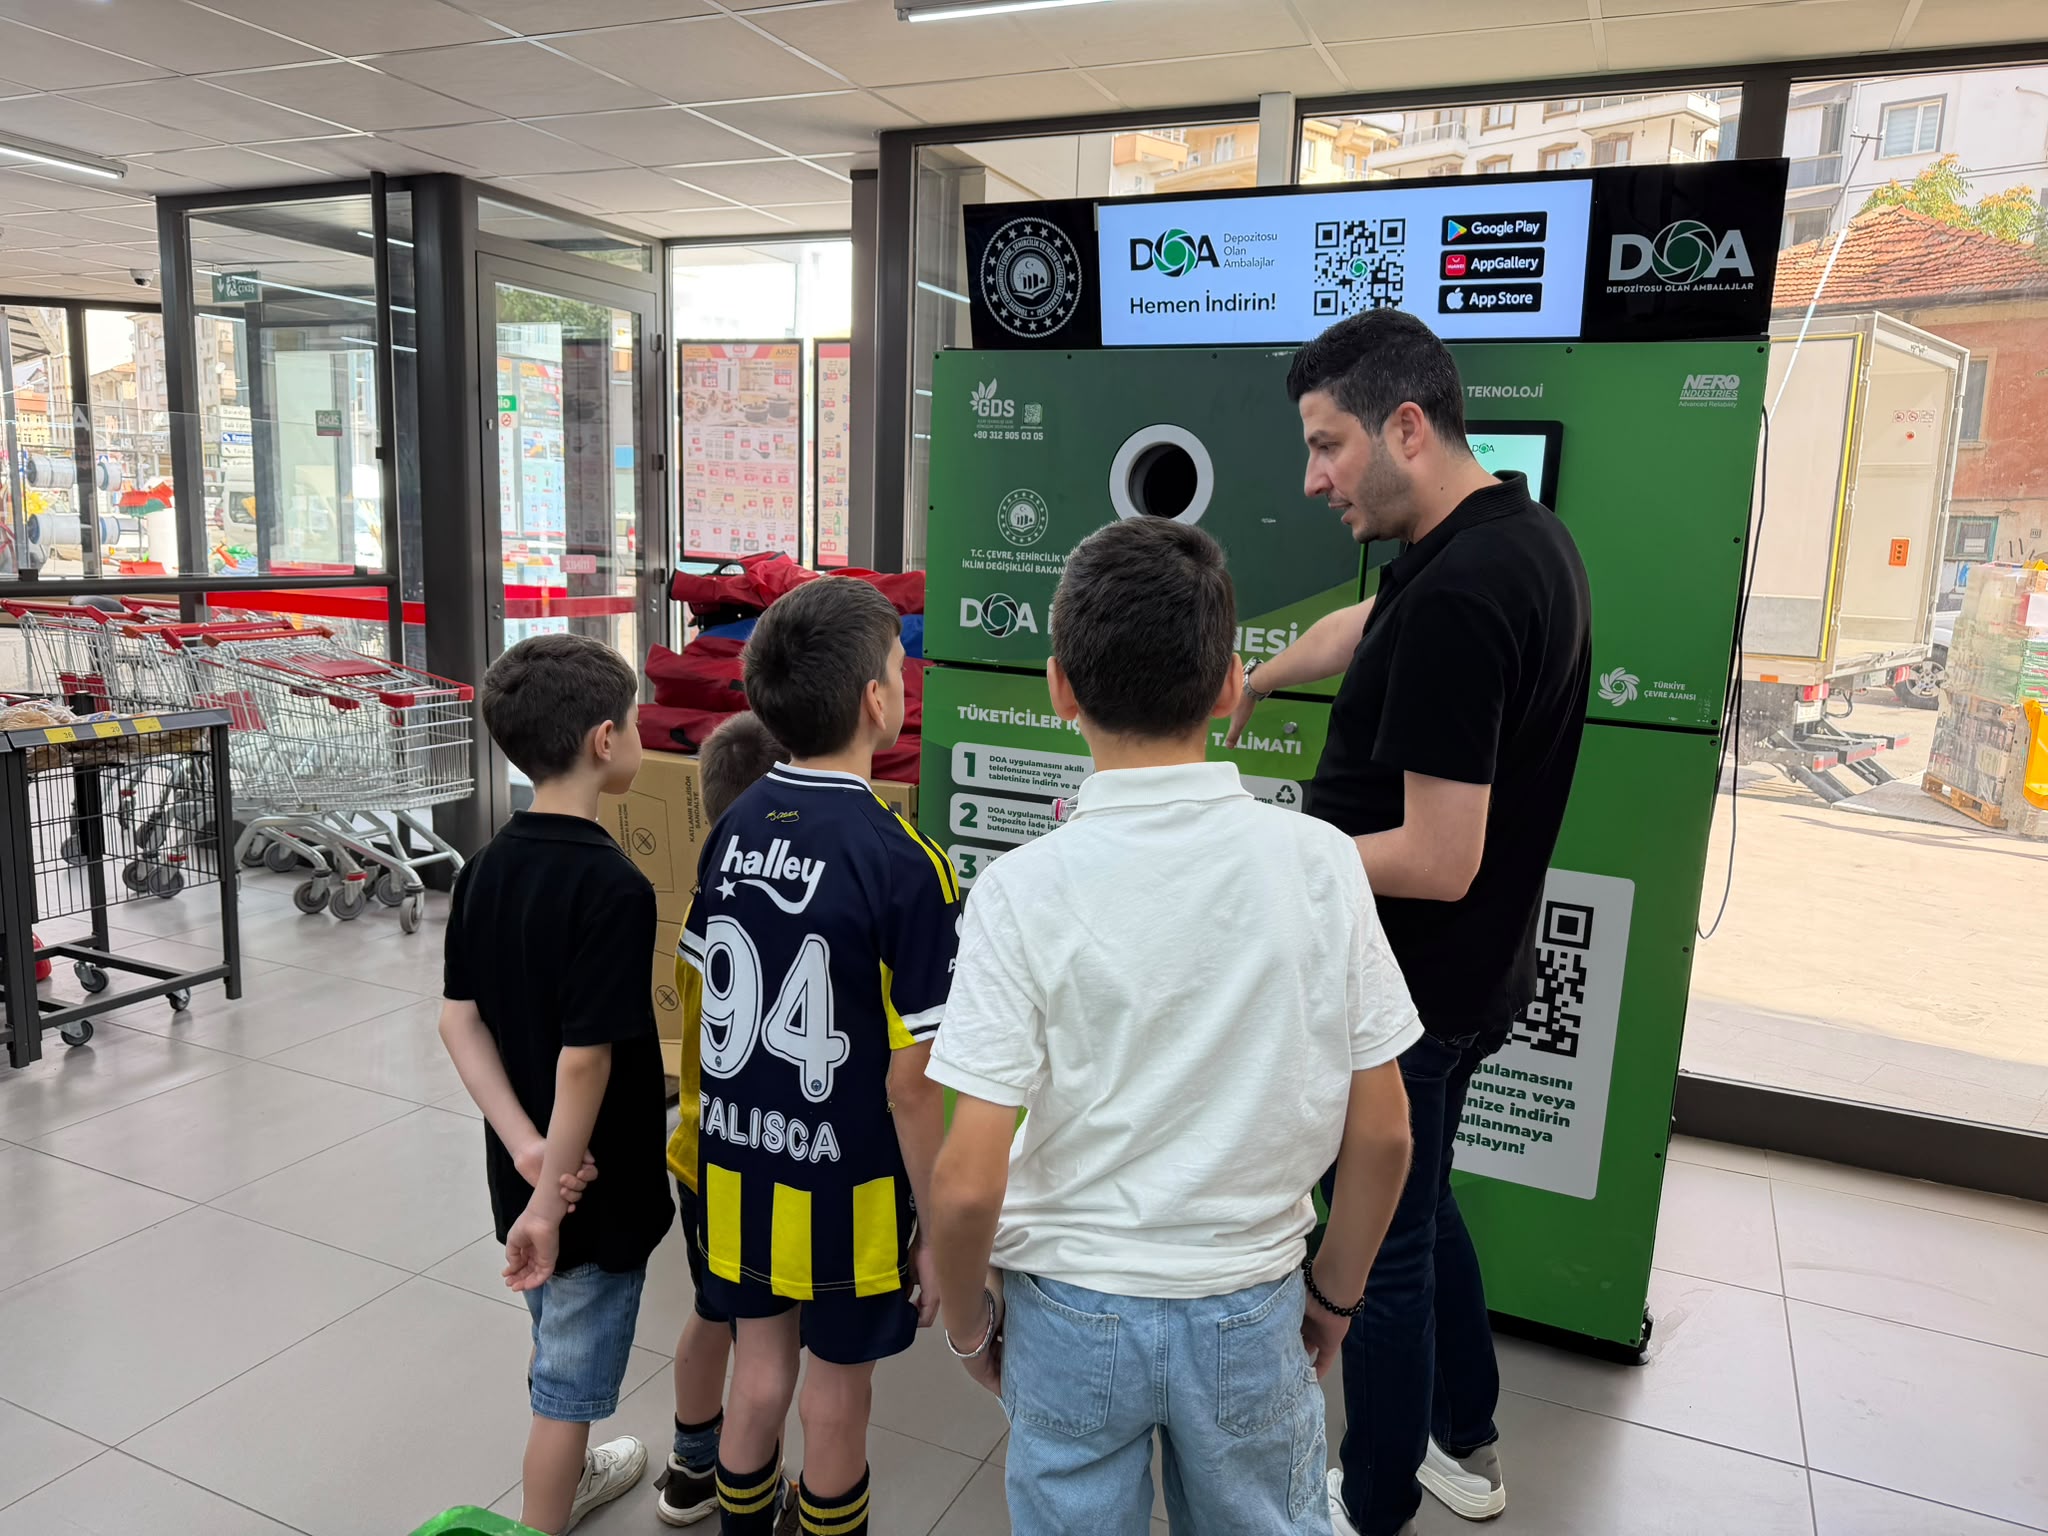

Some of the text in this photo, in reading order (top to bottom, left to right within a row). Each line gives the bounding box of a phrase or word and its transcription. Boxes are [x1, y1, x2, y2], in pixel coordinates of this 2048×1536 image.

[1471, 219, 1540, 237] Google Play
[1223, 232, 1278, 245] Depozitosu
[1130, 228, 1220, 277] DOA
[1223, 246, 1247, 256] Olan
[1608, 220, 1755, 284] DOA
[1223, 257, 1275, 269] Ambalajlar
[1471, 256, 1539, 272] AppGallery
[1606, 282, 1754, 294] DEPOZİTOSU OLAN AMBALAJLAR
[1130, 290, 1276, 314] Hemen İndirin!
[1469, 292, 1534, 308] App Store
[1467, 383, 1543, 398] TEKNOLOJİ
[978, 399, 1015, 417] GDS
[989, 431, 1003, 440] 312
[1005, 432, 1020, 440] 905
[1021, 432, 1031, 440] 03
[1033, 432, 1044, 441] 05
[971, 549, 985, 558] T.C.
[986, 550, 1014, 560] ÇEVRE,
[1016, 551, 1060, 562] ŞEHİRCİLİK
[962, 558, 1068, 575] İKLİM DEĞİŞİKLİĞİ BAKAN
[960, 593, 1038, 638] DOA
[1643, 690, 1697, 700] ÇEVRE AJANSI
[1653, 681, 1686, 691] TÜRKİYE
[957, 704, 1062, 730] TÜKETİCİLER
[963, 751, 976, 778] 1
[989, 755, 1084, 773] DOA uygulamasını akıllı
[989, 764, 1062, 779] telefonunuza veya
[988, 773, 1031, 785] tabletinize
[959, 802, 978, 829] 2
[987, 806, 1005, 815] DOA
[986, 824, 1024, 835] butonuna
[720, 835, 826, 915] halley
[957, 853, 977, 879] 3
[700, 915, 850, 1103] 94
[1469, 1080, 1575, 1110] unuza veya
[1464, 1096, 1570, 1128] nize indirin
[1460, 1113, 1553, 1142] ullanmaya
[1455, 1131, 1526, 1154] aşlayın!
